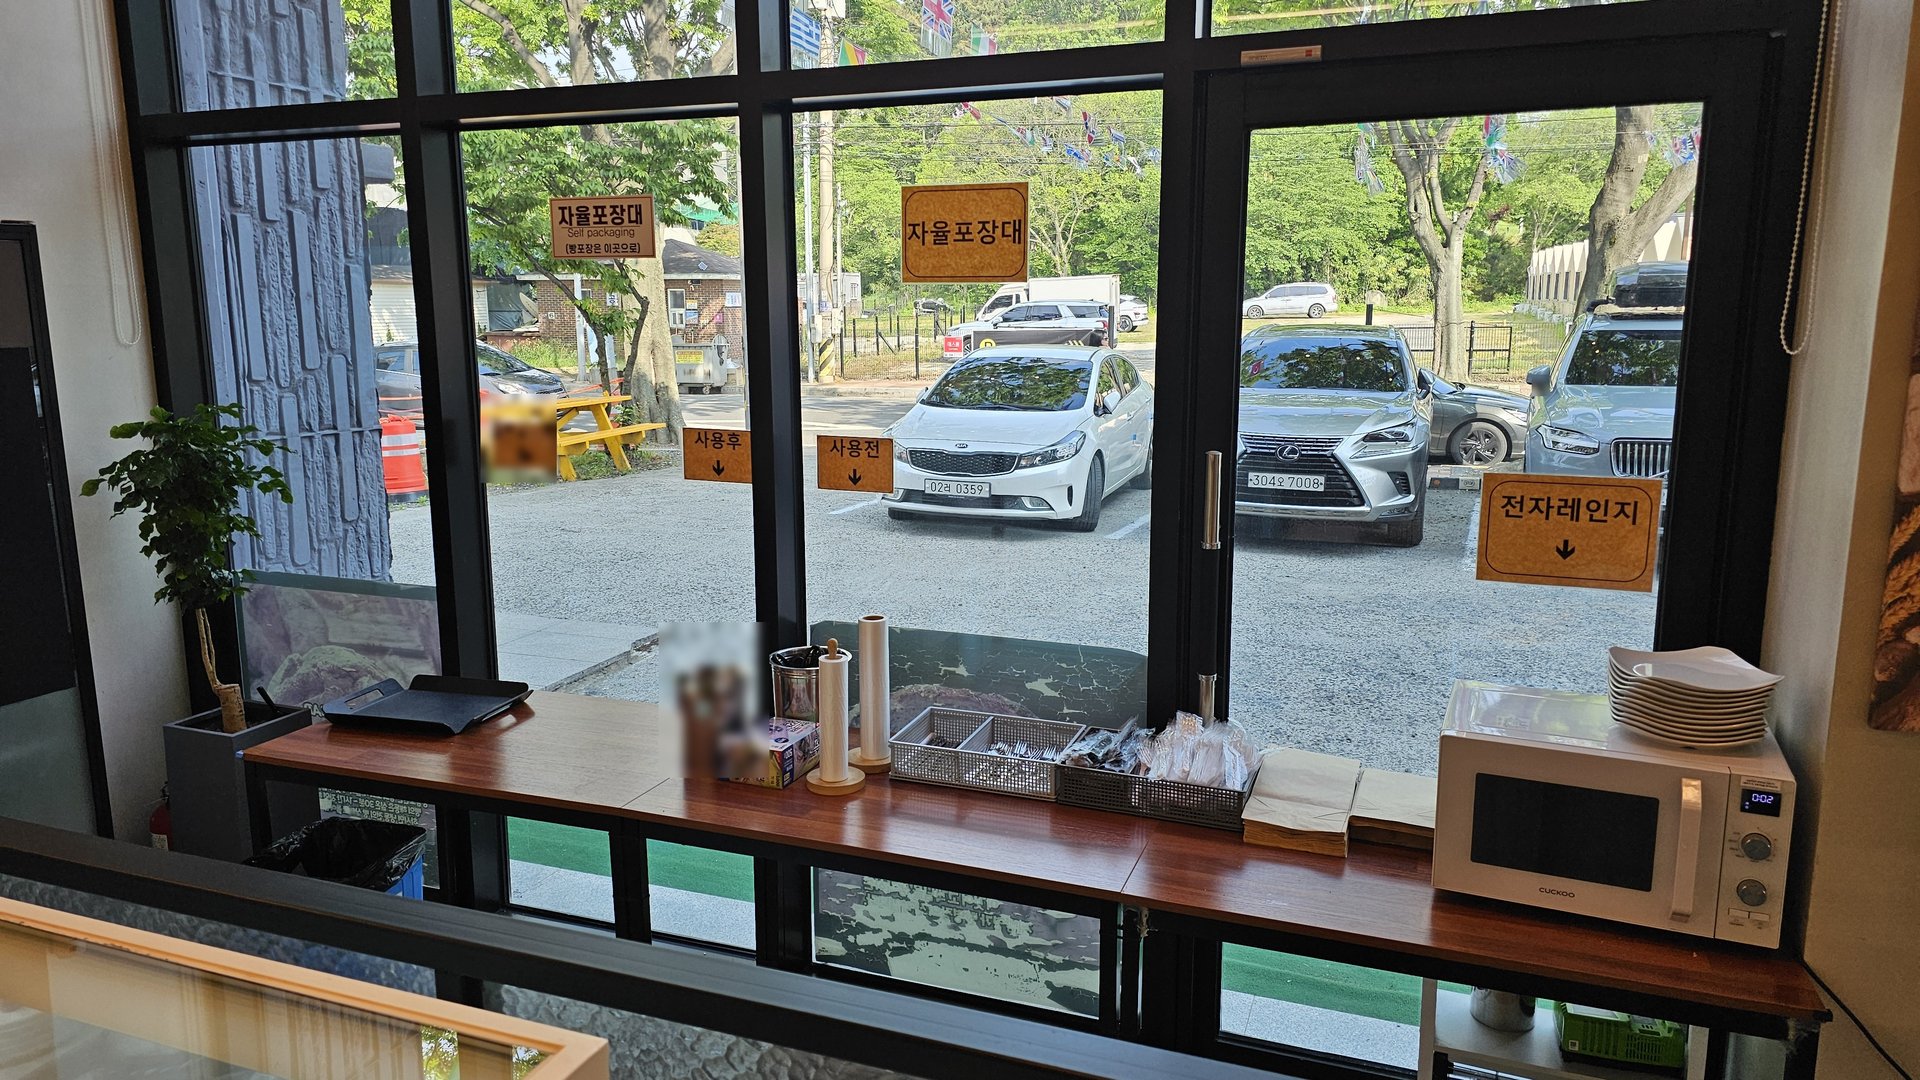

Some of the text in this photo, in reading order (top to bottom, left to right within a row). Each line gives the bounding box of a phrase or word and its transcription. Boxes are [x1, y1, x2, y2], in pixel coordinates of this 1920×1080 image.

[558, 204, 642, 226] 자율포장대
[568, 227, 635, 239] Self packaging
[907, 219, 1021, 246] 자율포장대
[566, 242, 641, 254] (빵포장은 이곳으로)
[694, 431, 742, 450] 사용후
[830, 439, 880, 459] 사용전
[956, 483, 984, 495] 0359
[1252, 474, 1320, 489] 304오 7008
[1500, 494, 1639, 526] 전자레인지
[1539, 887, 1576, 898] CUCKOO
